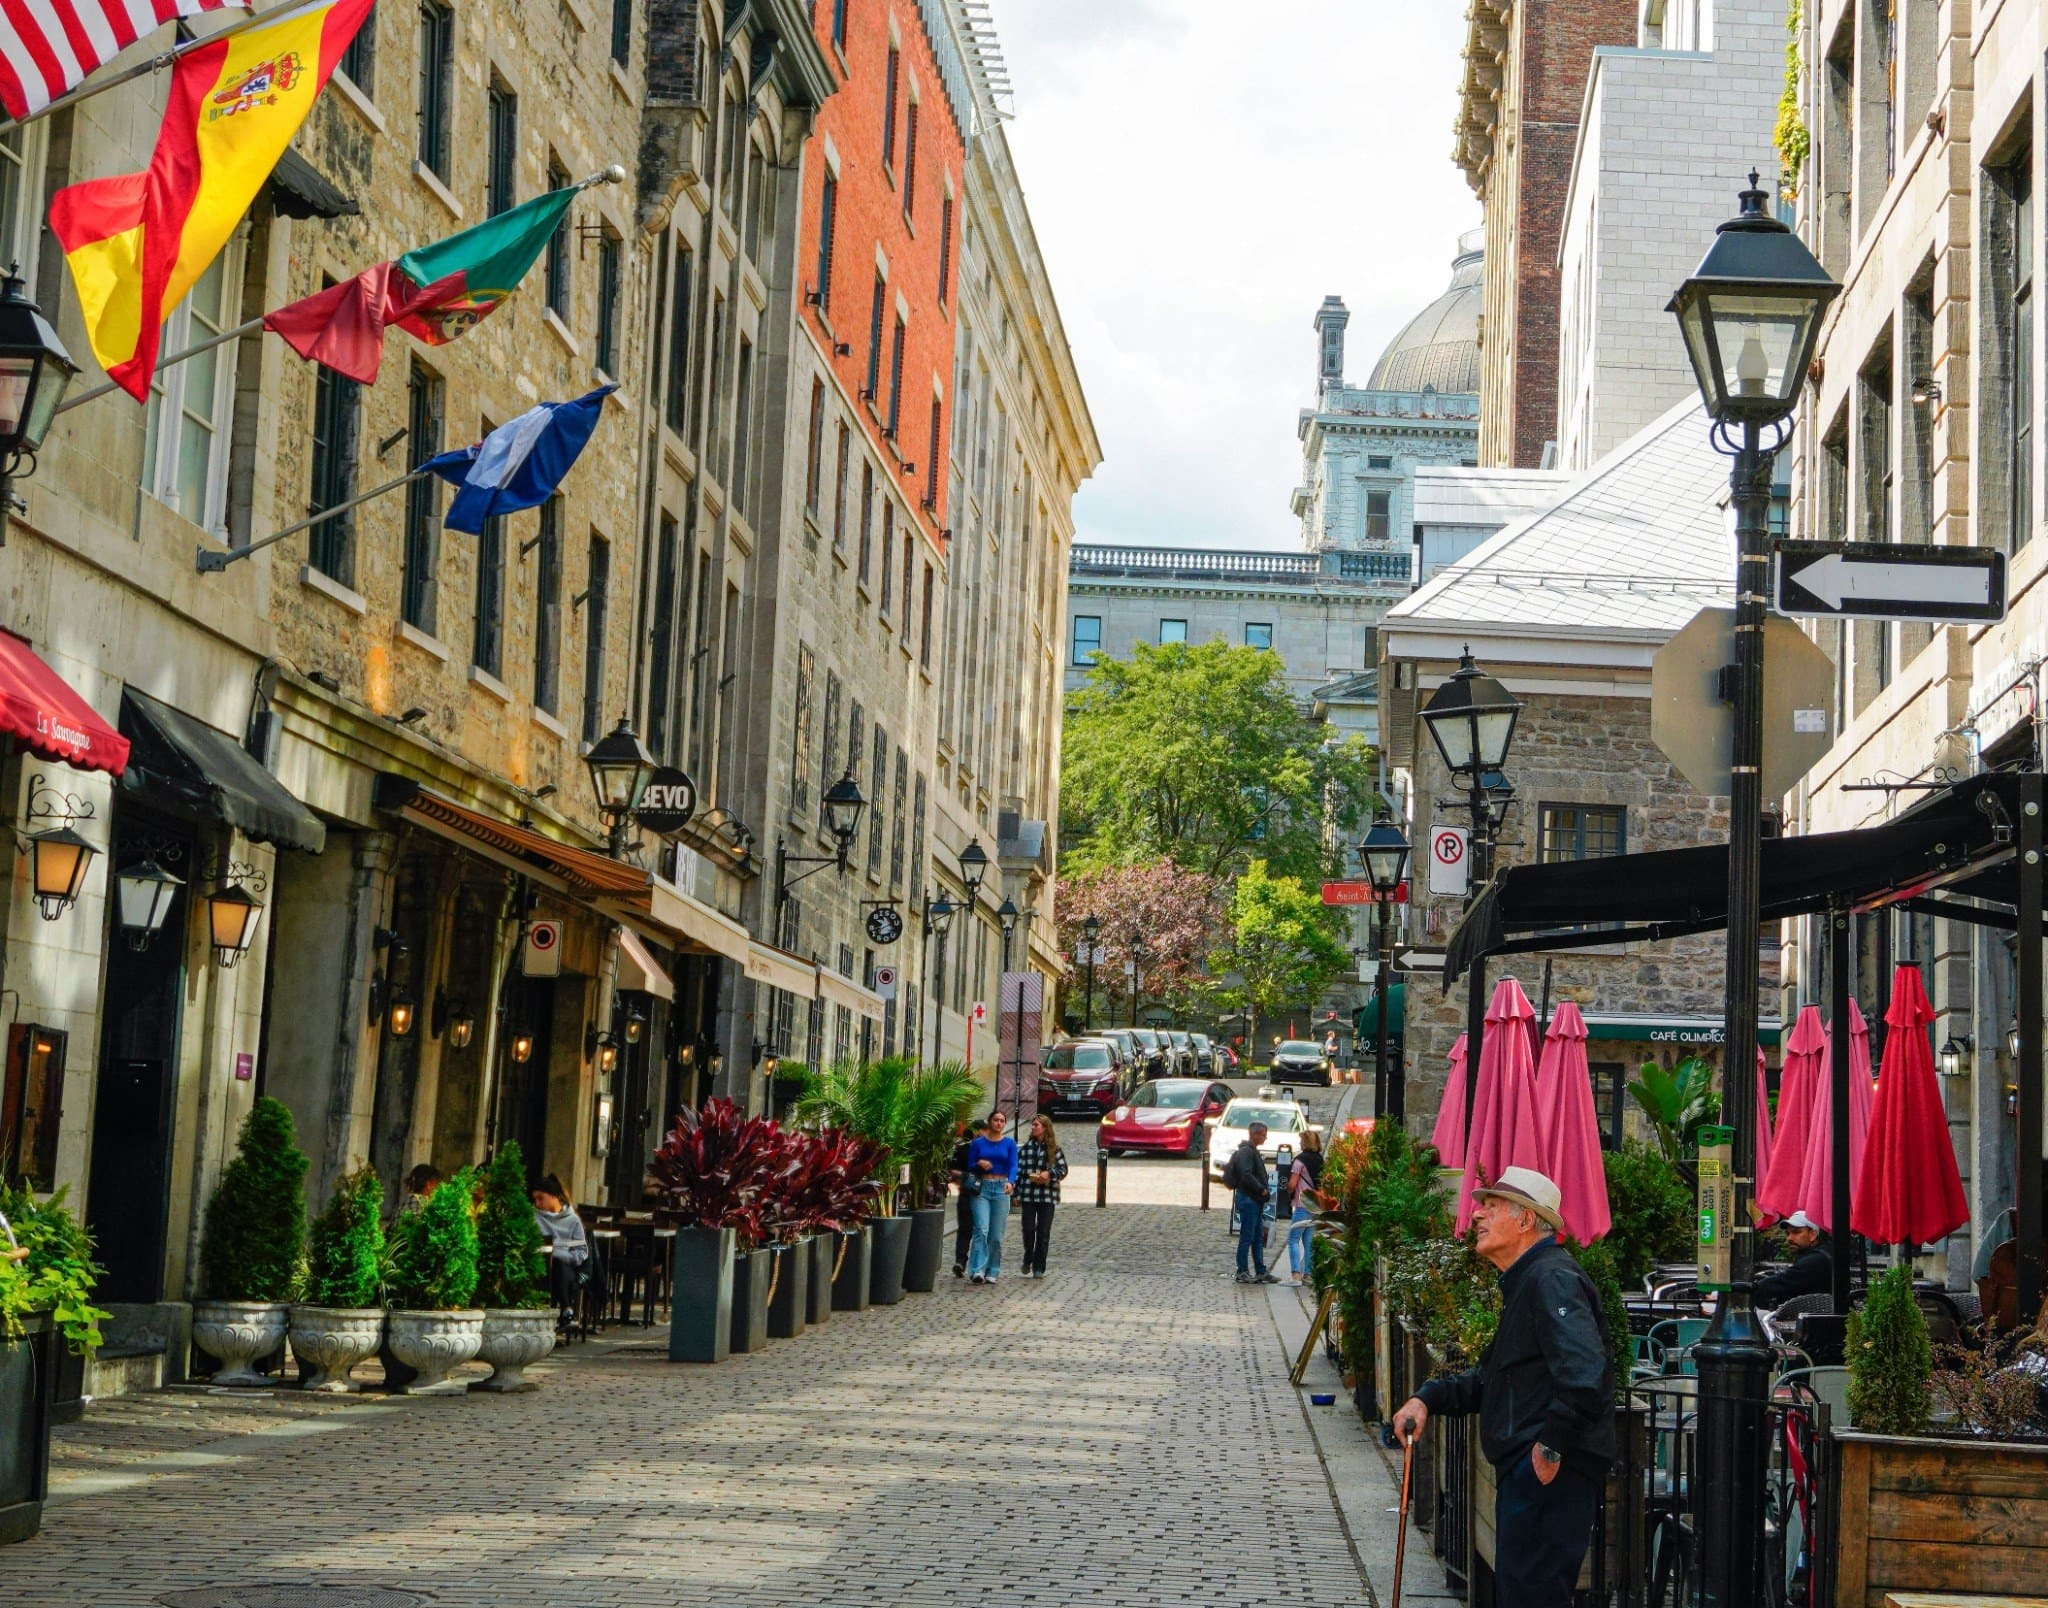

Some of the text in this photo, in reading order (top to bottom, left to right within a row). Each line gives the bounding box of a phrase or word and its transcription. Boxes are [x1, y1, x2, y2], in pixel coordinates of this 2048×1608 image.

[37, 711, 90, 754] La Sauvagine
[639, 785, 689, 809] BEVO
[1445, 839, 1456, 857] P
[1650, 1030, 1678, 1041] CAFÉ
